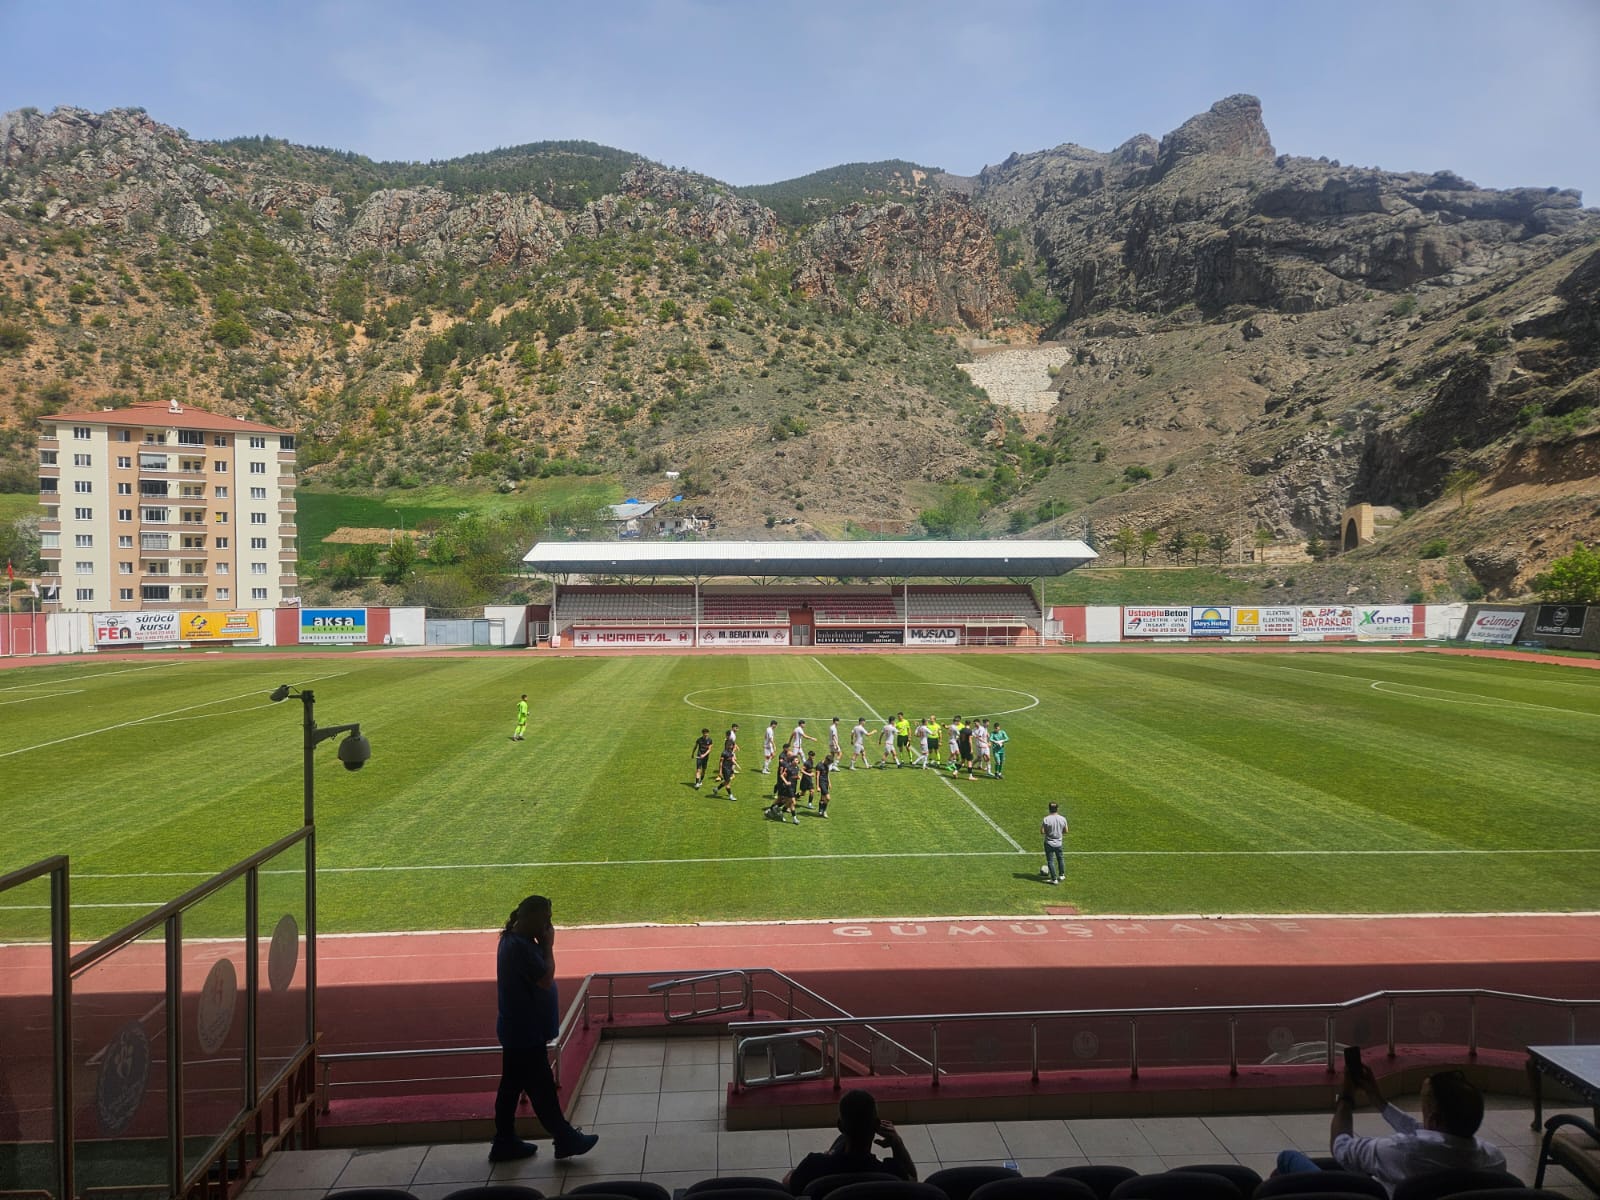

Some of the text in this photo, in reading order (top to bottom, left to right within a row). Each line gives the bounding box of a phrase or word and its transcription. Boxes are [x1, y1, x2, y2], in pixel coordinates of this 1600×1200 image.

[136, 614, 174, 622] sürücü
[314, 616, 354, 626] aksa
[1302, 618, 1352, 626] BAYRAKLAR
[140, 623, 171, 631] kursu
[597, 633, 671, 642] HÜRMETAL
[832, 922, 1308, 938] GÜMÜŞHANE
